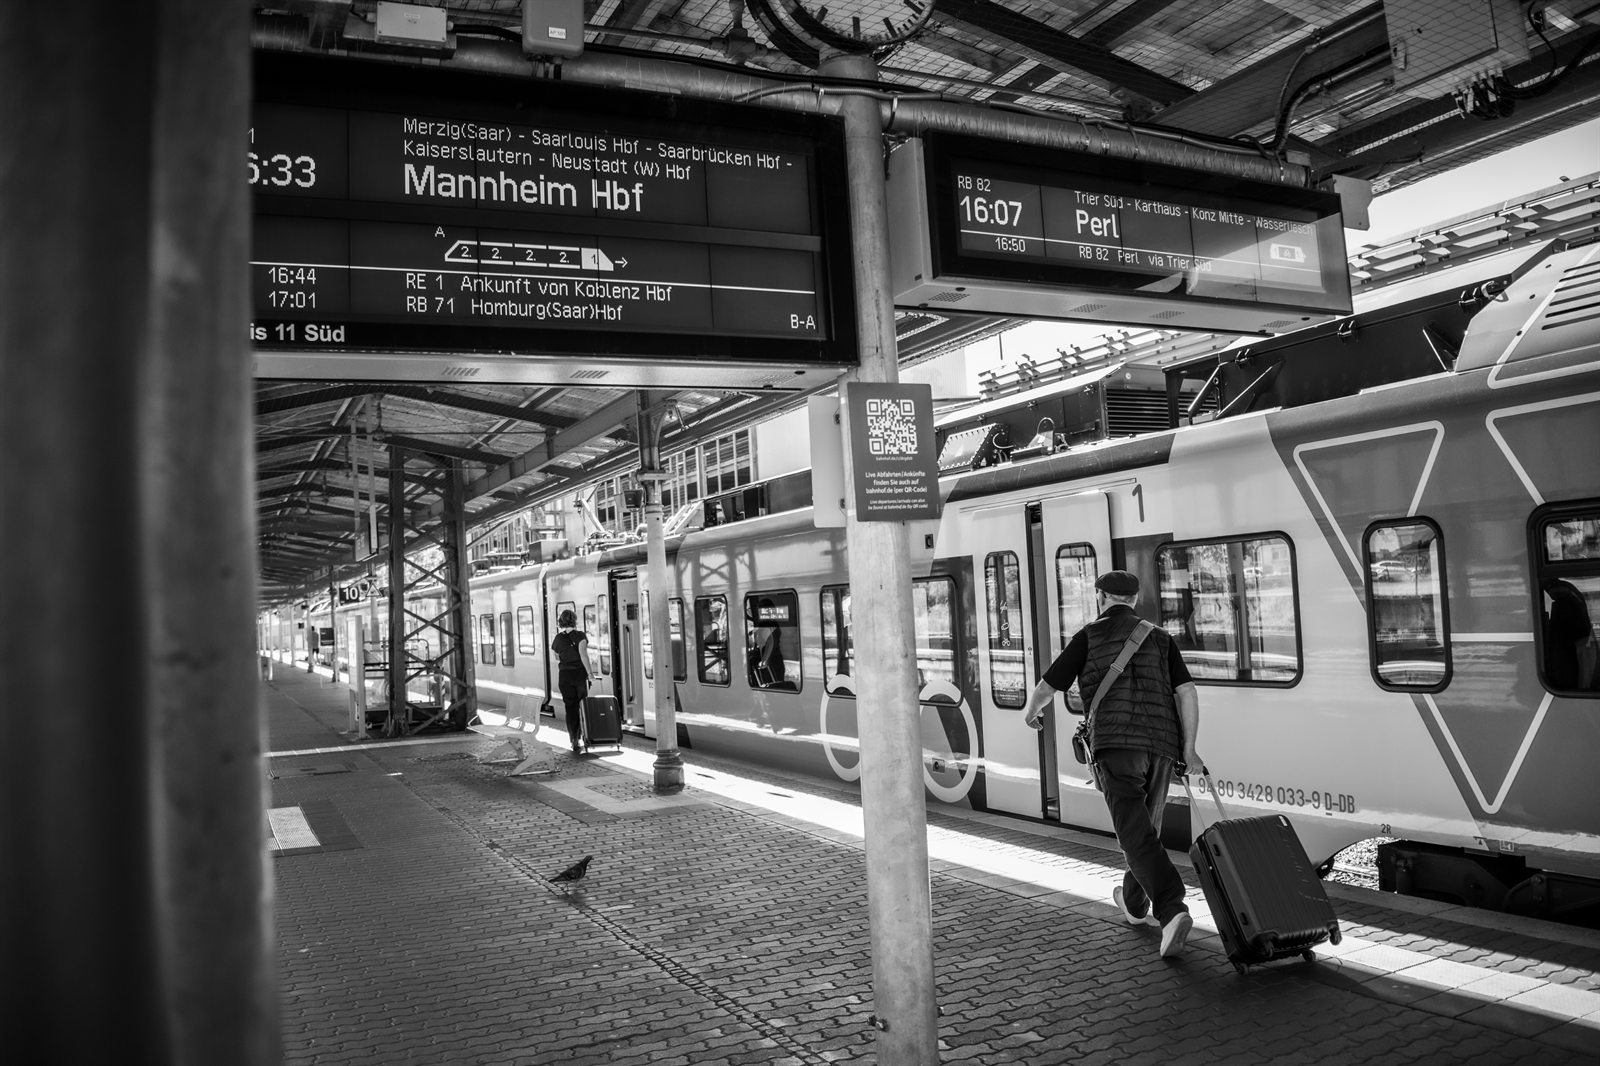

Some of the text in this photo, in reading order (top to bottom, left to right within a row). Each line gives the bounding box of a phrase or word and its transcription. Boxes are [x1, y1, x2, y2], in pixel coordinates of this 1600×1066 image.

[404, 117, 512, 142] Merzig(Saar)
[532, 130, 607, 151] Saarlouis
[613, 138, 639, 155] Hbf
[658, 143, 752, 167] Saarbrücken
[757, 153, 781, 170] Hbf
[404, 140, 532, 166] Kaiserslautern
[552, 152, 628, 174] Neustadt
[634, 161, 660, 178] (W)
[666, 164, 691, 181] Hbf
[404, 163, 644, 212] Mannheim Hbf
[958, 176, 991, 192] RB 82
[960, 195, 1022, 227] 16:07
[1074, 190, 1100, 206] Trier
[1104, 194, 1124, 209] Süd
[1134, 199, 1182, 217] Karthaus
[1192, 207, 1216, 222] Konz
[1219, 210, 1244, 226] Mitte
[434, 226, 446, 238] A
[1076, 209, 1119, 238] Perl
[995, 237, 1026, 252] 16:50
[1078, 246, 1092, 259] RB
[1096, 248, 1109, 260] 82
[1118, 250, 1140, 264] Perl
[1148, 254, 1164, 267] via
[1167, 255, 1190, 270] Trier
[268, 266, 672, 302] 16:44 RE 1 Ankunft von Koblenz Hbf
[268, 290, 623, 320] 17:01 RB 71 Homburg(Saar)Hbf
[275, 323, 295, 341] 11
[304, 324, 345, 342] Süd
[790, 314, 816, 330] B-A
[1131, 484, 1144, 522] 1
[342, 587, 358, 600] 10
[1217, 779, 1234, 798] 80
[1237, 782, 1274, 803] 3428
[1276, 786, 1320, 810] 033-9
[1324, 792, 1355, 814] D-DB
